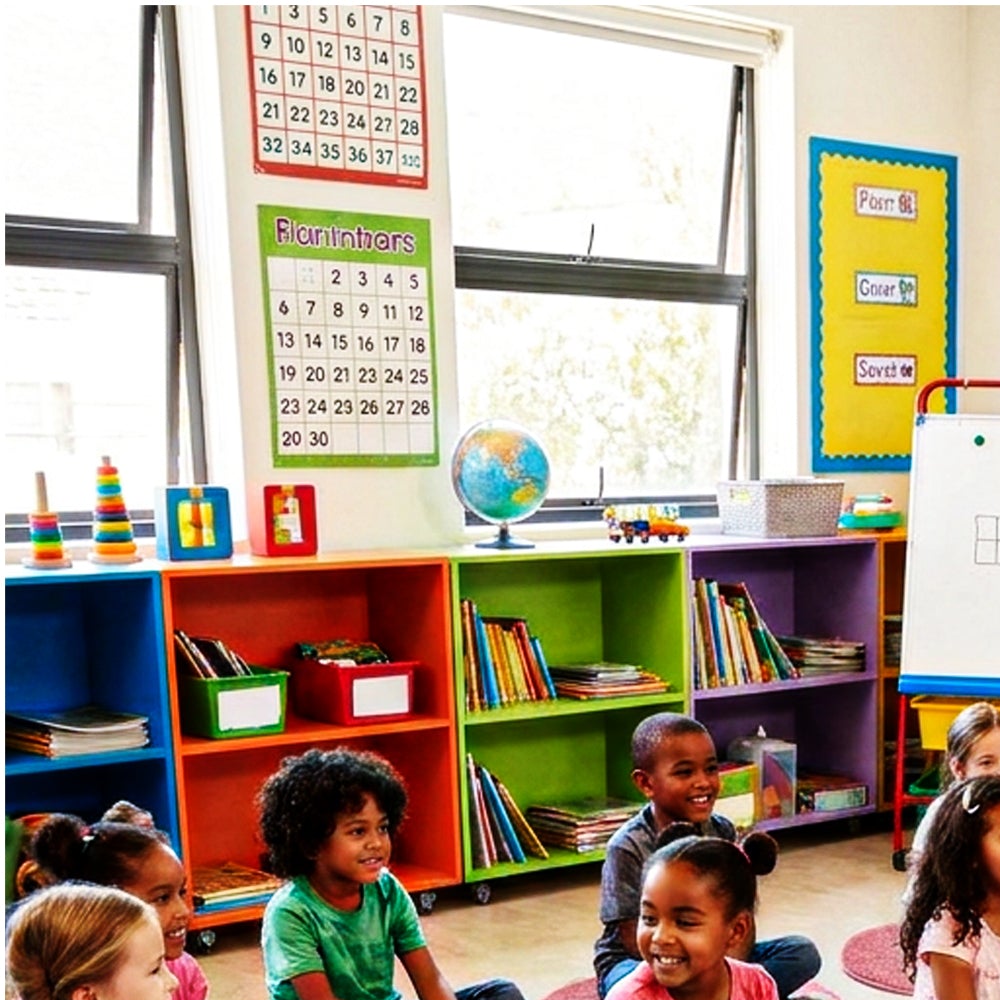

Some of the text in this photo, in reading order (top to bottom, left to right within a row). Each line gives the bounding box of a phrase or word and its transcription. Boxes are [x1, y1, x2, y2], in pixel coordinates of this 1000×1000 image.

[289, 5, 299, 18] 3
[319, 8, 328, 23] 5
[347, 13, 356, 28] 6
[374, 16, 382, 31] 7
[401, 20, 410, 36] 8
[261, 33, 415, 70] 9 10 12 13 14 15
[260, 68, 417, 103] 16 17 18 20 21 22
[263, 103, 279, 119] 21
[291, 107, 309, 123] 22
[320, 111, 338, 126] 23
[348, 114, 365, 130] 24
[401, 120, 419, 135] 28
[263, 137, 282, 153] 32
[292, 140, 311, 156] 34
[321, 144, 340, 160] 35
[349, 147, 367, 162] 36
[376, 150, 393, 164] 37
[331, 269, 419, 289] 2 3 4 5
[279, 300, 423, 321] 6 7 8 9 11 12
[277, 332, 425, 353] 13 14 15 16 17 18
[280, 366, 428, 384] 19 20 21 23 24 25
[281, 399, 300, 414] 23
[308, 400, 327, 414] 24
[386, 400, 404, 415] 27
[309, 431, 328, 446] 30
